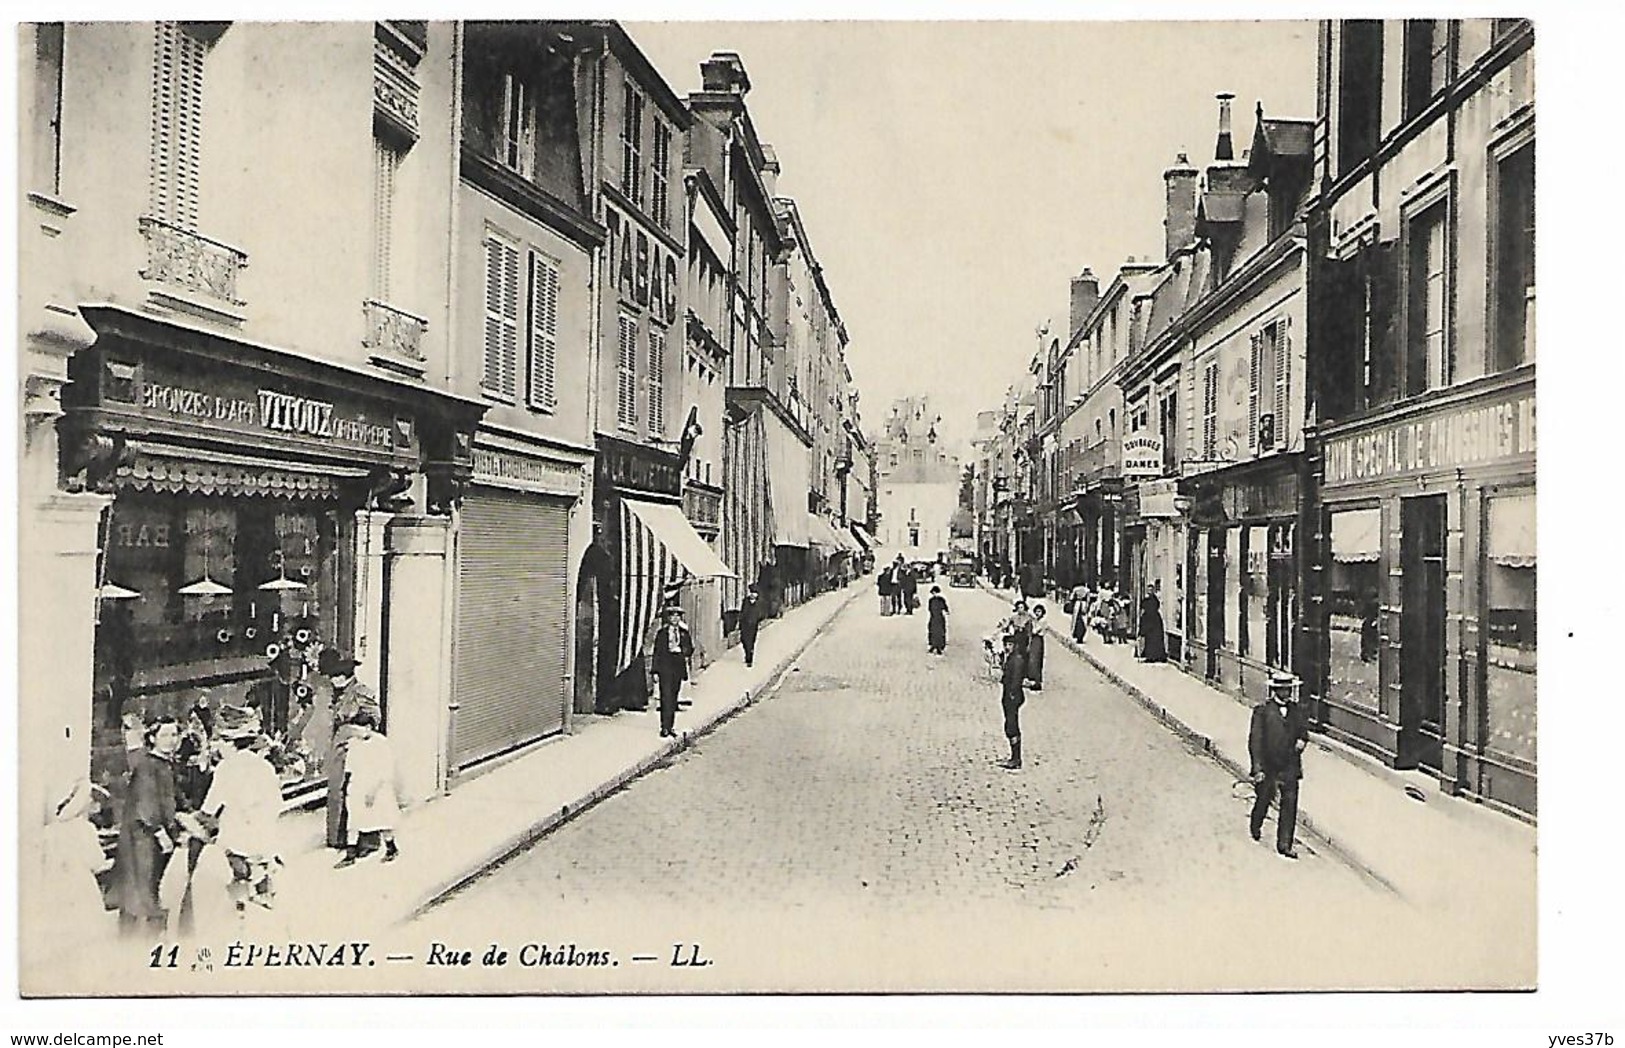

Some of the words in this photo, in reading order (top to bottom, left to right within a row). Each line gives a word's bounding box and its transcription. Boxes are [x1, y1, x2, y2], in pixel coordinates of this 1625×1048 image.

[605, 204, 677, 326] TABAC
[142, 383, 212, 418] BRONZES
[257, 389, 333, 437] VITOUX
[1126, 460, 1159, 468] DAMES
[149, 944, 181, 968] 11
[426, 943, 473, 967] Rue
[482, 944, 508, 967] de
[519, 944, 619, 967] Châlons.
